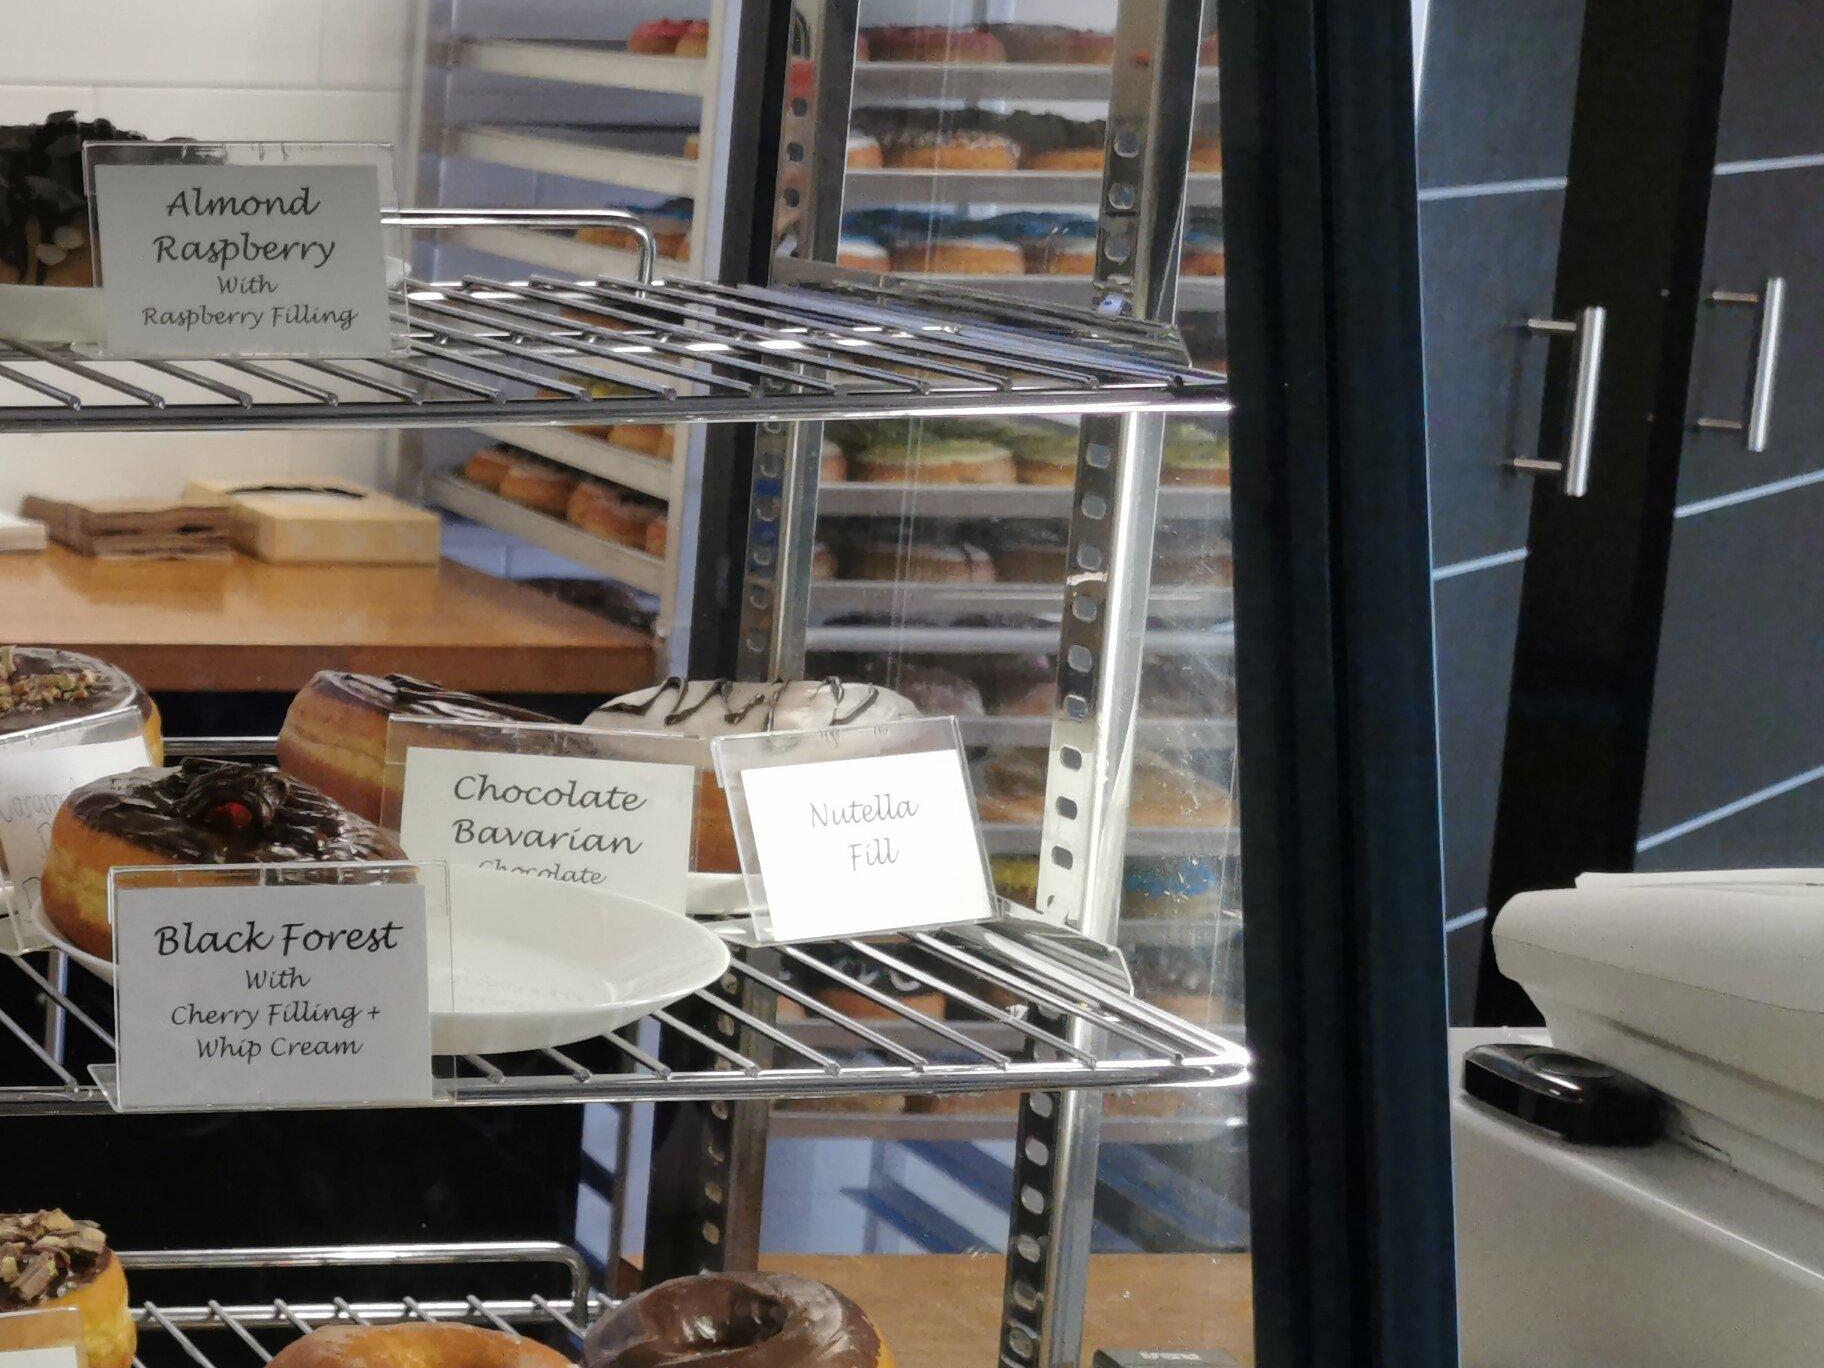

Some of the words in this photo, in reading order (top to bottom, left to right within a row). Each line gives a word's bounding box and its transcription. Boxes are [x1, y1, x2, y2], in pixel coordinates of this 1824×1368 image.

[167, 187, 320, 217] Almond
[152, 232, 336, 270] Raspberry
[218, 275, 278, 295] With
[142, 304, 264, 331] Raspberry
[271, 304, 359, 331] Filling
[454, 774, 647, 811] Chocolate
[809, 794, 920, 828] Nutella
[452, 819, 643, 854] Bavarian
[848, 838, 899, 872] Fill
[154, 921, 273, 955] Black
[281, 920, 403, 956] Forest
[245, 967, 310, 989] With
[171, 1002, 259, 1030] Cherry
[268, 1000, 363, 1027] Filling
[197, 1036, 261, 1064] Whip
[270, 1037, 363, 1057] Cream
